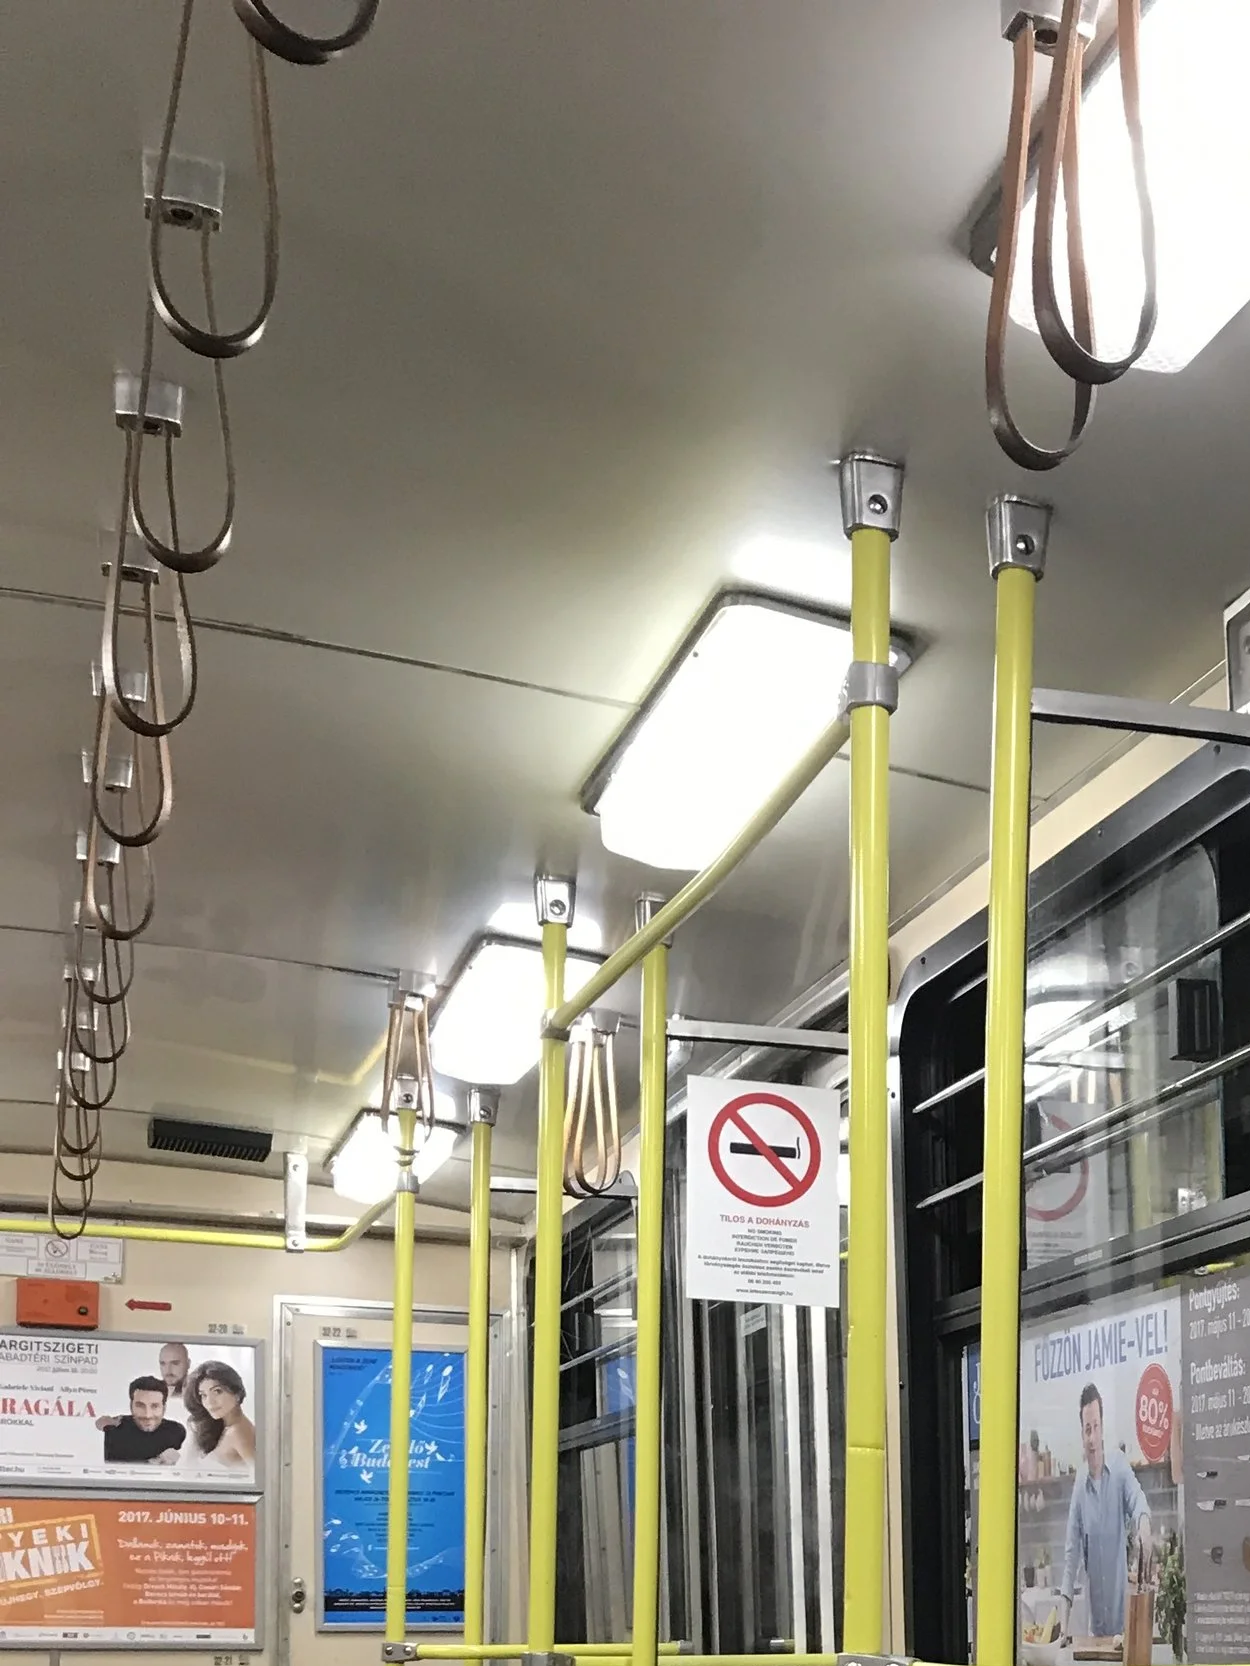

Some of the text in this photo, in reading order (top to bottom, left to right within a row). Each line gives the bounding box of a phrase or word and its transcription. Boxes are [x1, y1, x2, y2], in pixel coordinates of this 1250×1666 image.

[719, 1214, 811, 1229] TILOS A DOHÁNYZÁS
[1085, 1309, 1169, 1371] JAMIE-VEL!
[54, 1354, 99, 1366] SZÍNPAD
[0, 1395, 97, 1418] RAGÁLA
[1139, 1394, 1169, 1430] 80%
[368, 1439, 426, 1455] Zelő
[351, 1452, 431, 1469] Budest
[117, 1508, 249, 1526] 2017. JÚNIUS 10-11.
[5, 1522, 89, 1549] YEKI
